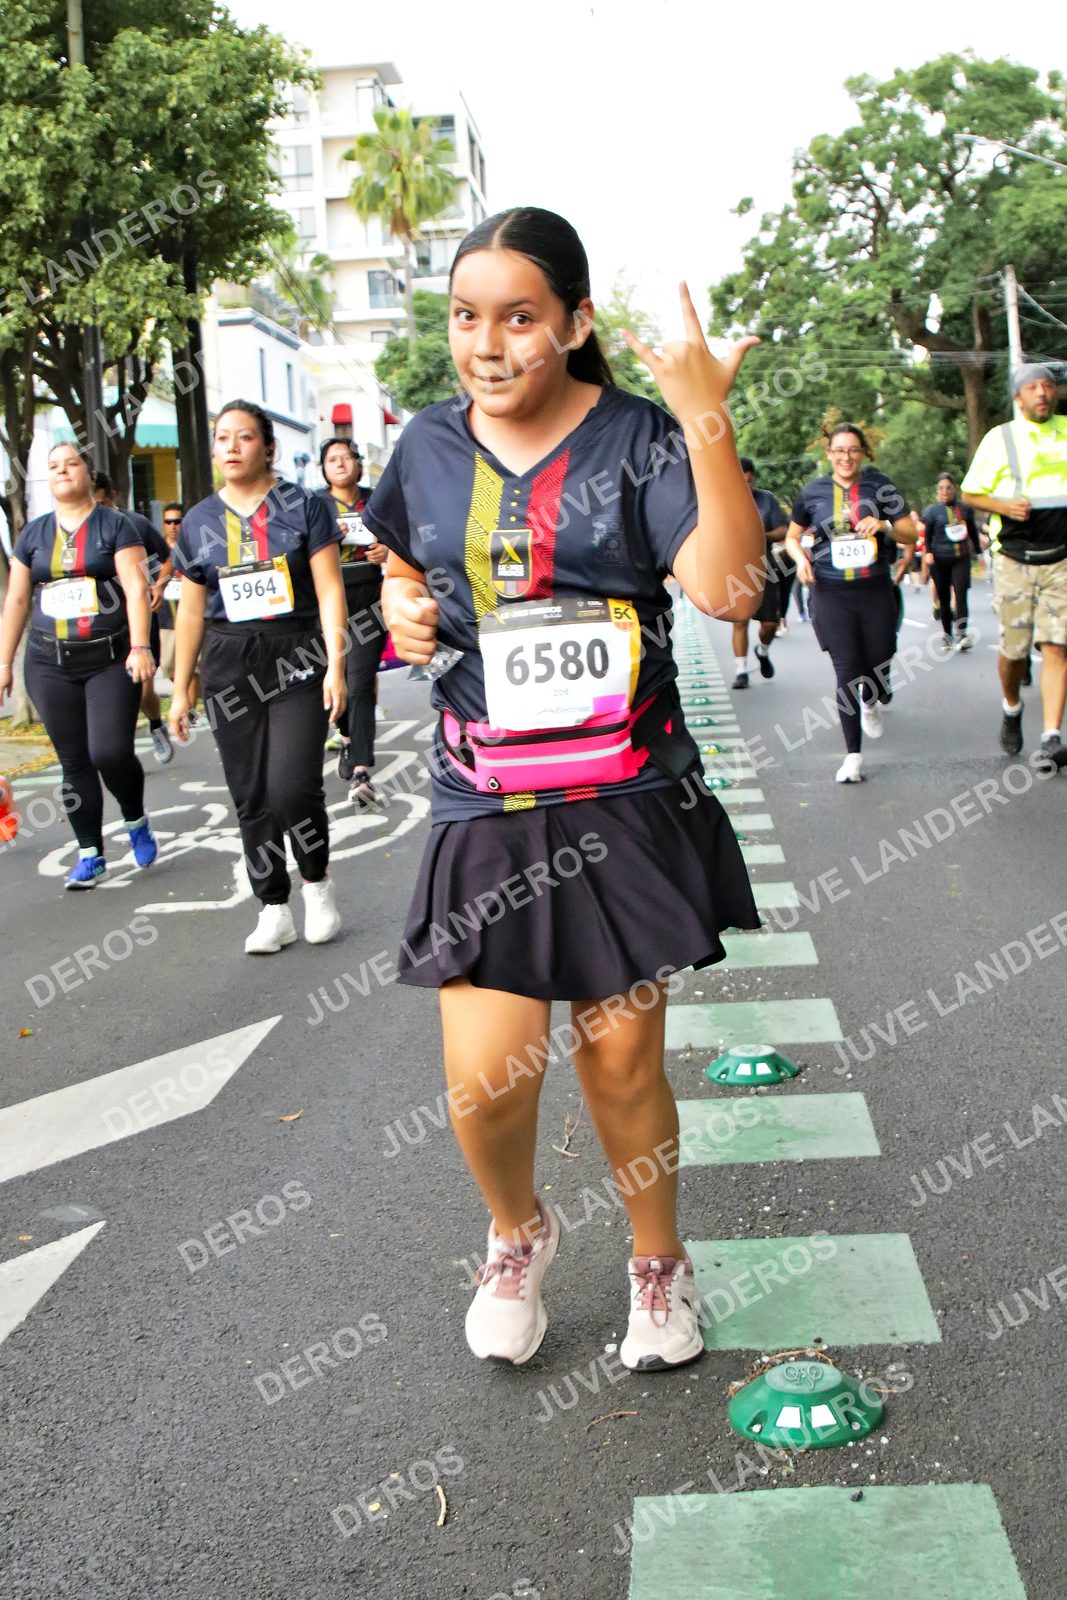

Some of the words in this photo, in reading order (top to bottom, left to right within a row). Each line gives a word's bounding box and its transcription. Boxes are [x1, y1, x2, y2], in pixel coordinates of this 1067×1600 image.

[839, 545, 867, 557] 4261
[232, 576, 277, 601] 5964
[613, 604, 633, 621] 5K
[505, 638, 610, 686] 6580
